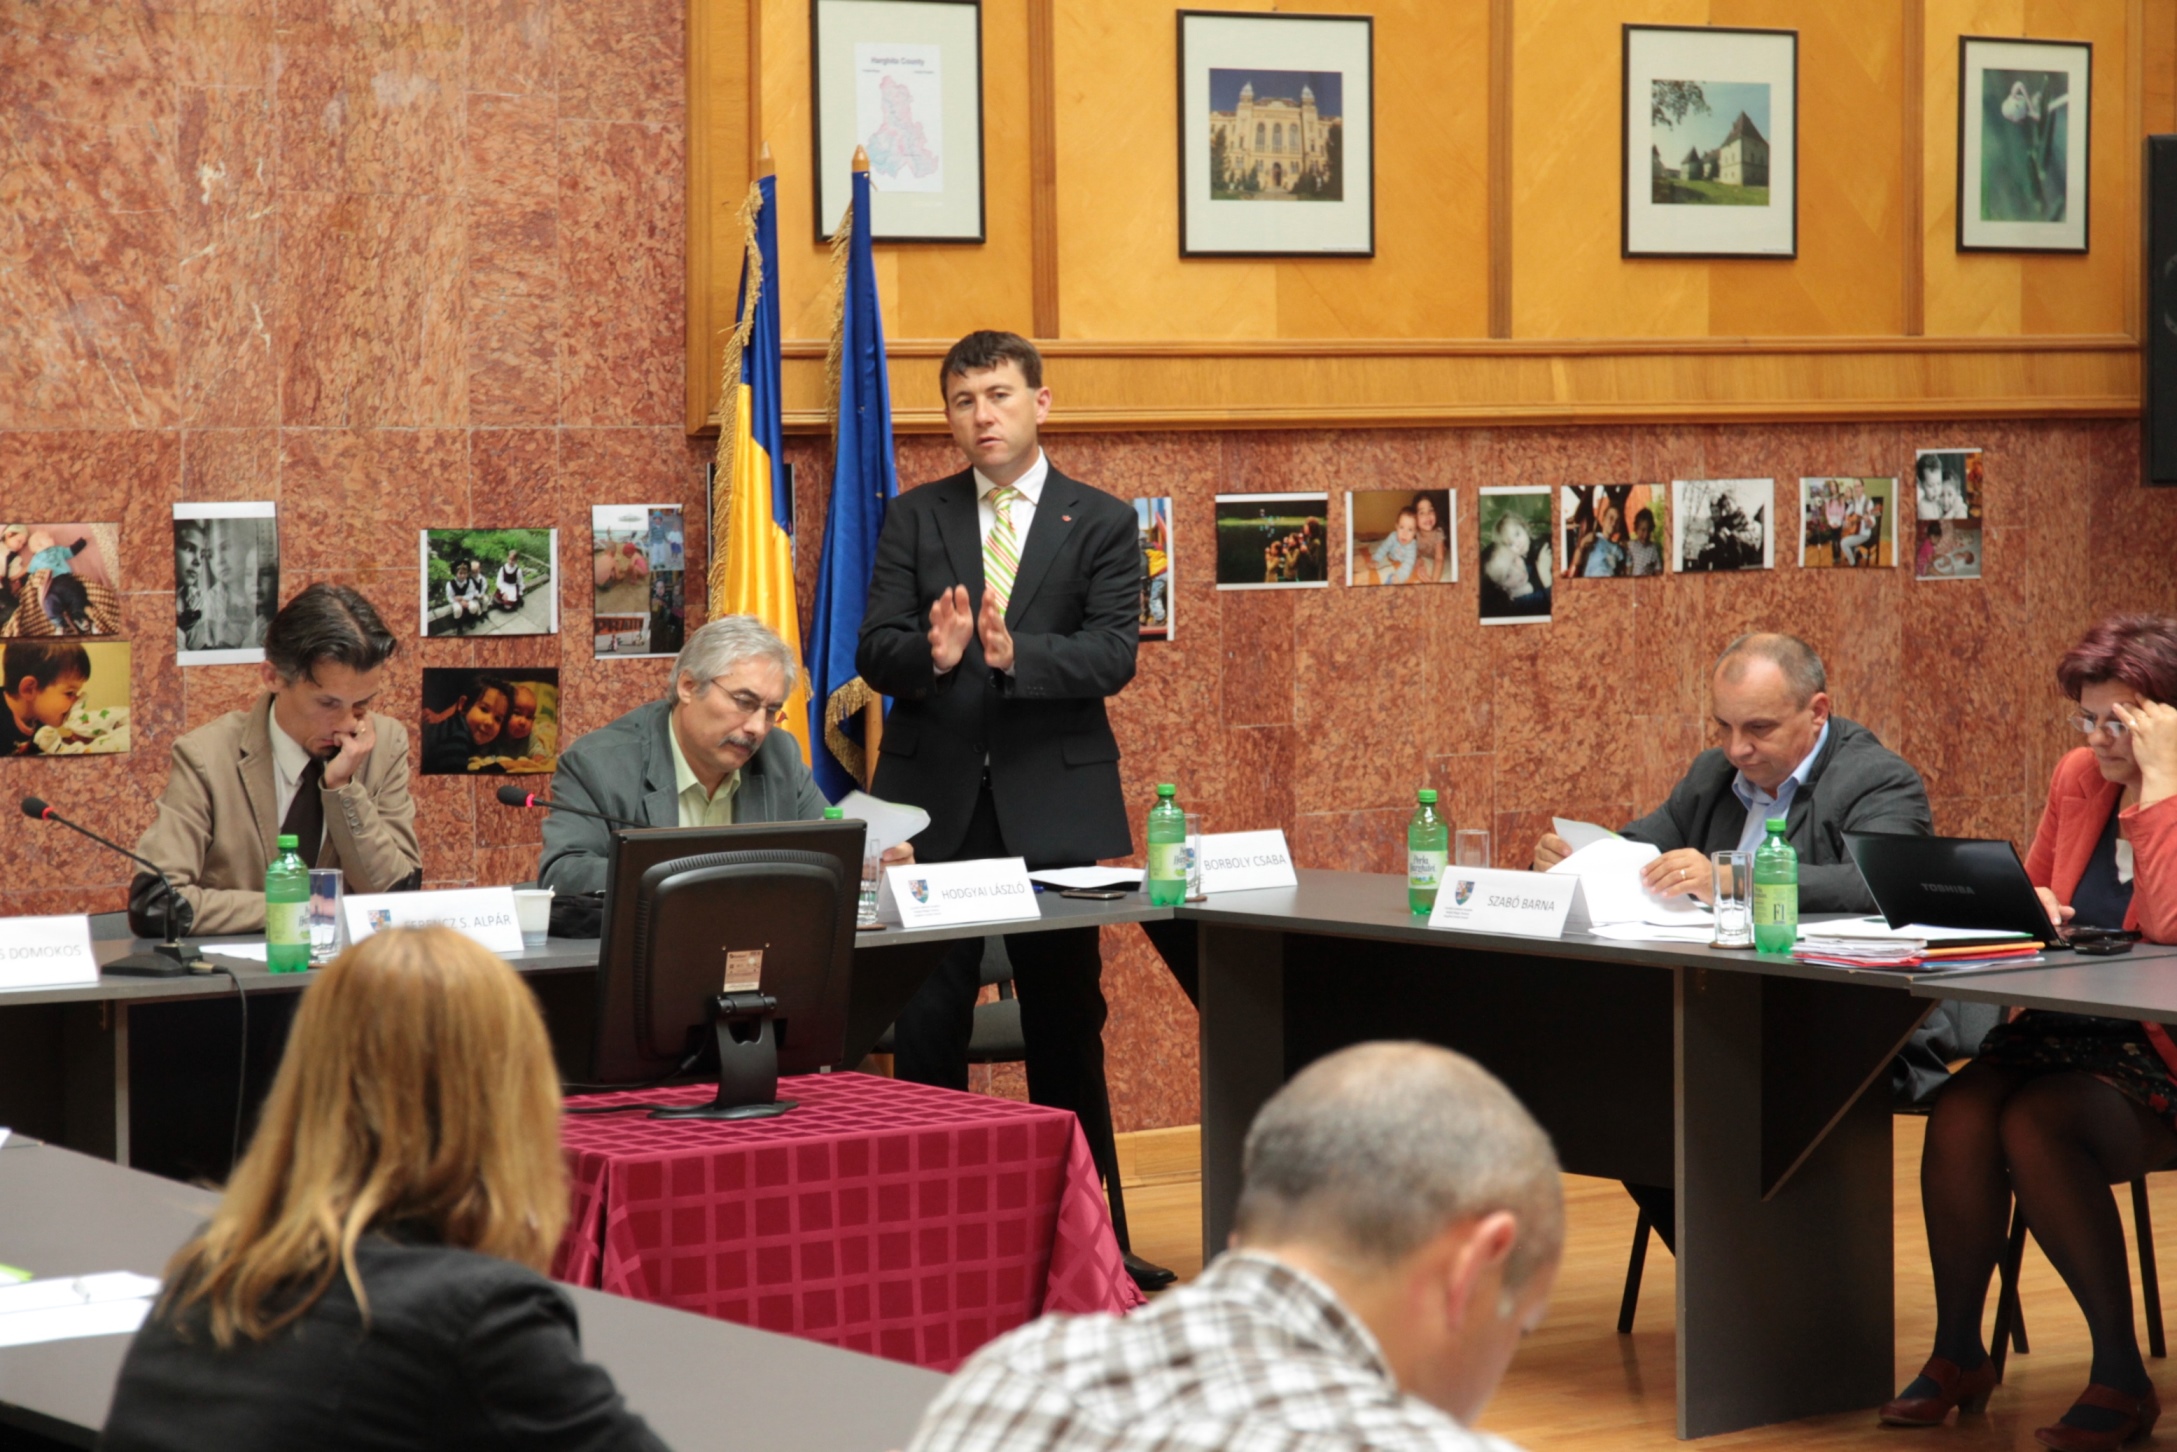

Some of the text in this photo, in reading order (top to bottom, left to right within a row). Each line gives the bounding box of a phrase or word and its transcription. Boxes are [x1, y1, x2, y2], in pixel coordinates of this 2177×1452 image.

[901, 57, 924, 67] County
[1203, 854, 1287, 871] BORBOLY CSABA
[941, 881, 1025, 900] HODGYAI LÁSZLÓ
[1920, 882, 1975, 895] TOSHIBA
[1487, 895, 1555, 911] SZABÓ BARNA
[461, 916, 471, 929] S.
[474, 912, 512, 927] ALPÁR
[9, 944, 82, 960] DOMOKOS
